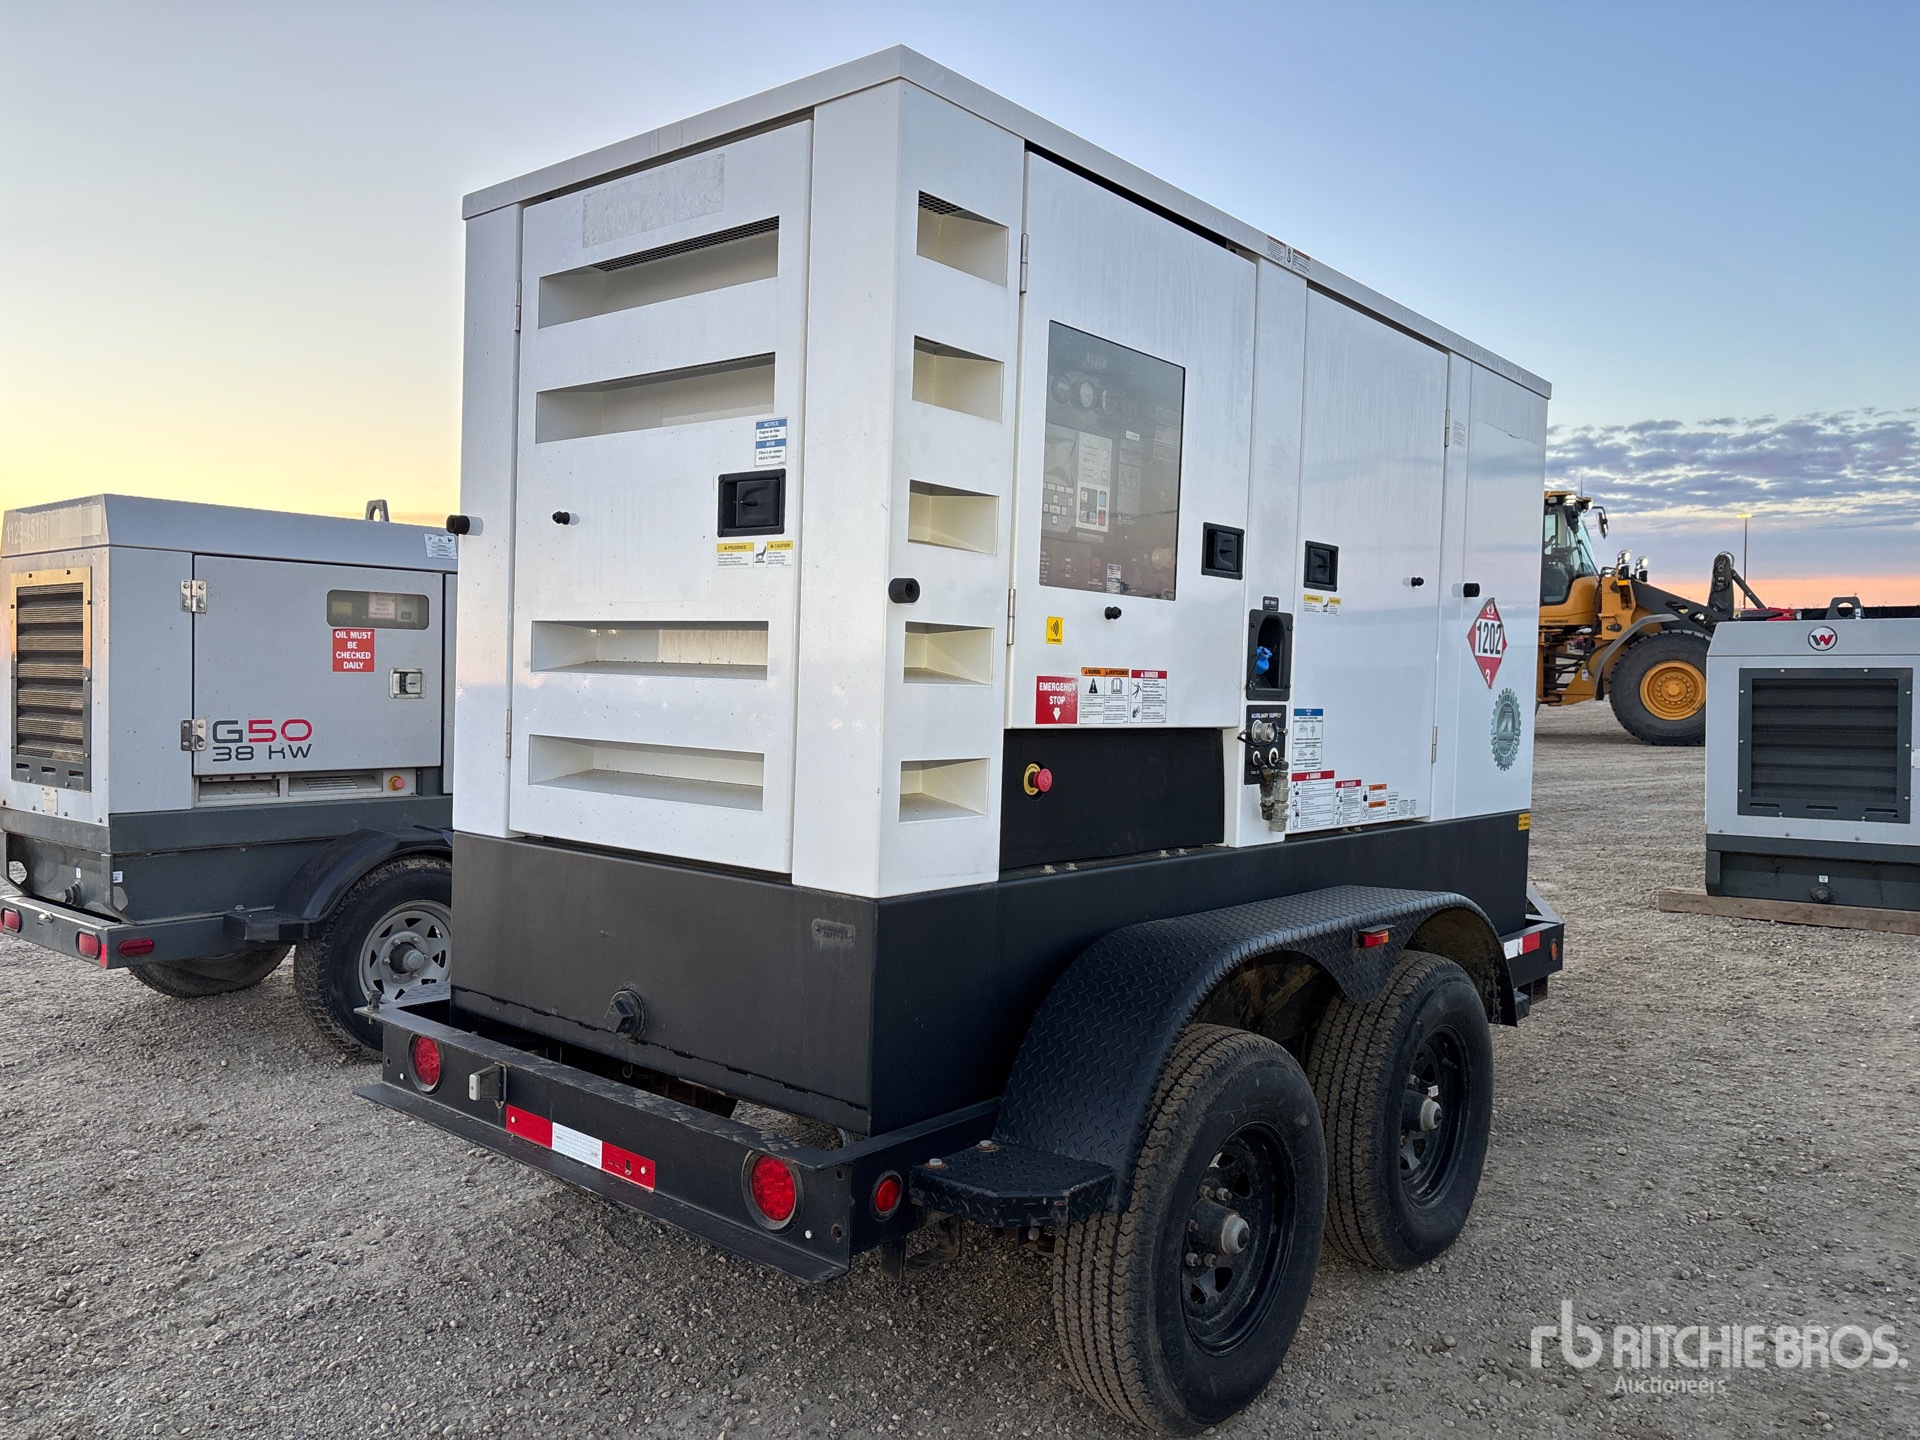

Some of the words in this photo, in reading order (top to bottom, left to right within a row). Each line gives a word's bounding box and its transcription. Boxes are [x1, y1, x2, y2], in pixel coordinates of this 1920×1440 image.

[335, 630, 348, 640] OIL
[350, 631, 372, 640] MUST
[1477, 621, 1502, 655] 1202
[347, 641, 358, 649] BE
[336, 651, 371, 660] CHECKED
[343, 661, 364, 670] DAILY
[1485, 669, 1491, 685] 3
[1039, 682, 1076, 692] EMERGENCY
[1049, 696, 1066, 705] STOP
[212, 718, 313, 744] G50
[212, 745, 255, 762] 38
